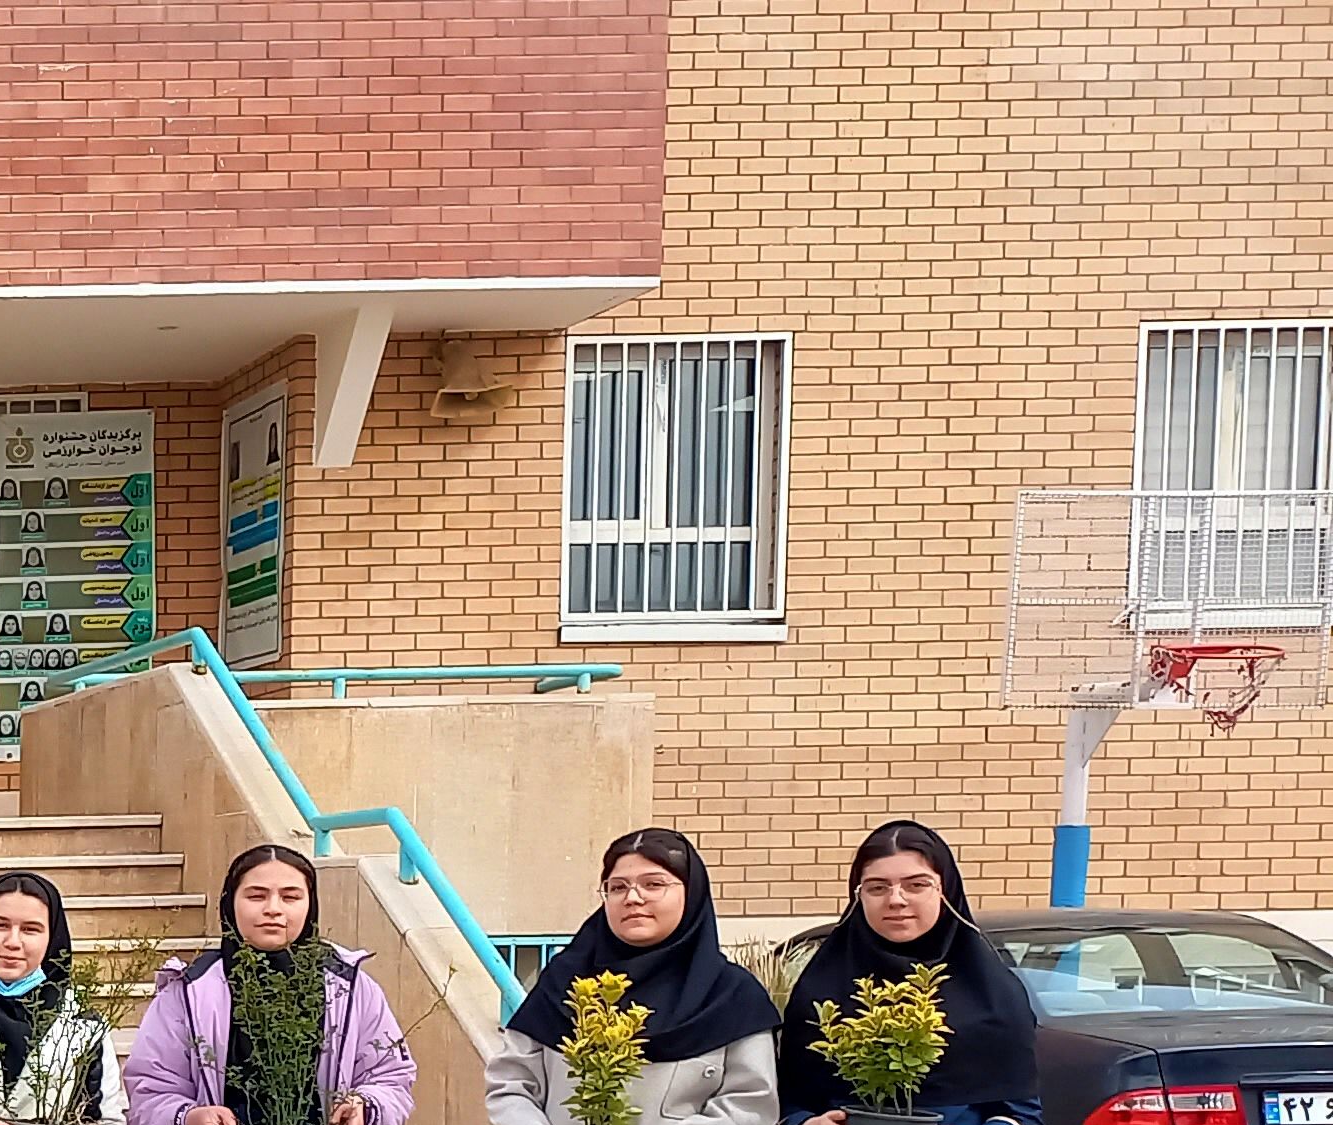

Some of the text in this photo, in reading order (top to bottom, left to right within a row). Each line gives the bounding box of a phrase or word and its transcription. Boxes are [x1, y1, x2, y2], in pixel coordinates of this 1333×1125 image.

[42, 427, 142, 444] برگزیدگان جشنواره
[42, 442, 143, 459] نوجوان خوارزمی
[1283, 1096, 1314, 1122] ۴۲
